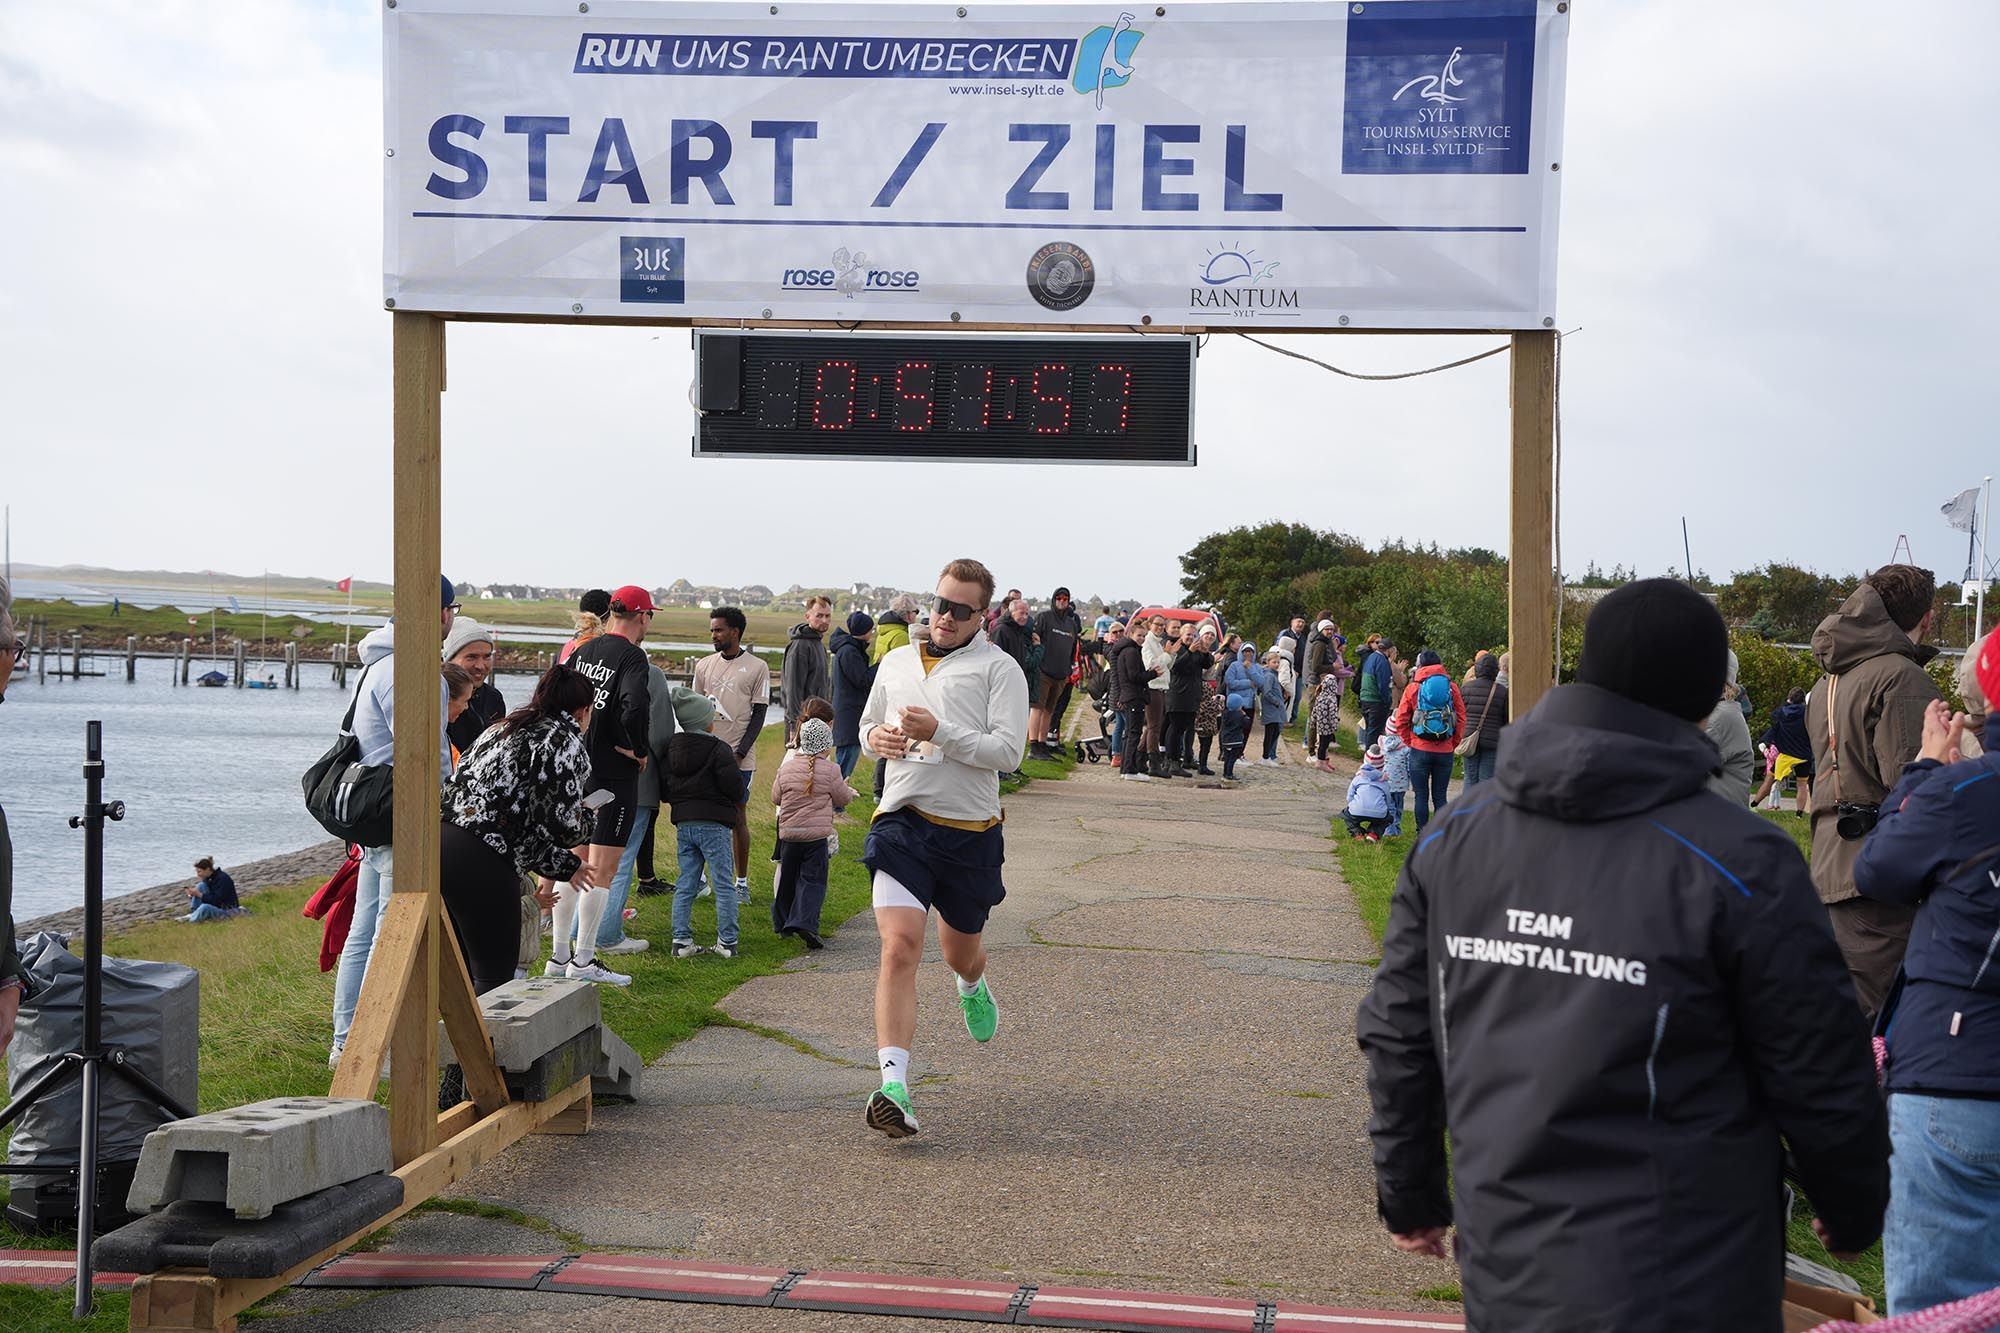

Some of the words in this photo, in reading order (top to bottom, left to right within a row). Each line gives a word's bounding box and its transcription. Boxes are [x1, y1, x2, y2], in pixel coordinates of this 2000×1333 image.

[581, 38, 662, 67] RUN
[671, 40, 752, 69] UMS
[761, 41, 1068, 73] RANTUMBECKEN
[949, 84, 1064, 98] www.insel-sylt.de
[1417, 107, 1458, 123] SYLT
[1362, 126, 1511, 139] TOURISMUS-SERVICE
[1386, 143, 1485, 155] INSEL-SYLT.DE
[425, 114, 818, 206] START
[870, 123, 948, 207] /
[1005, 124, 1283, 211] ZIEL
[782, 269, 835, 286] rose
[866, 270, 920, 287] rose
[646, 286, 658, 294] Sylt
[1190, 288, 1300, 308] RANTUM
[1233, 310, 1255, 318] SYLT
[1506, 909, 1573, 940] TEAM
[1445, 935, 1647, 986] VERANSTALTUNG
